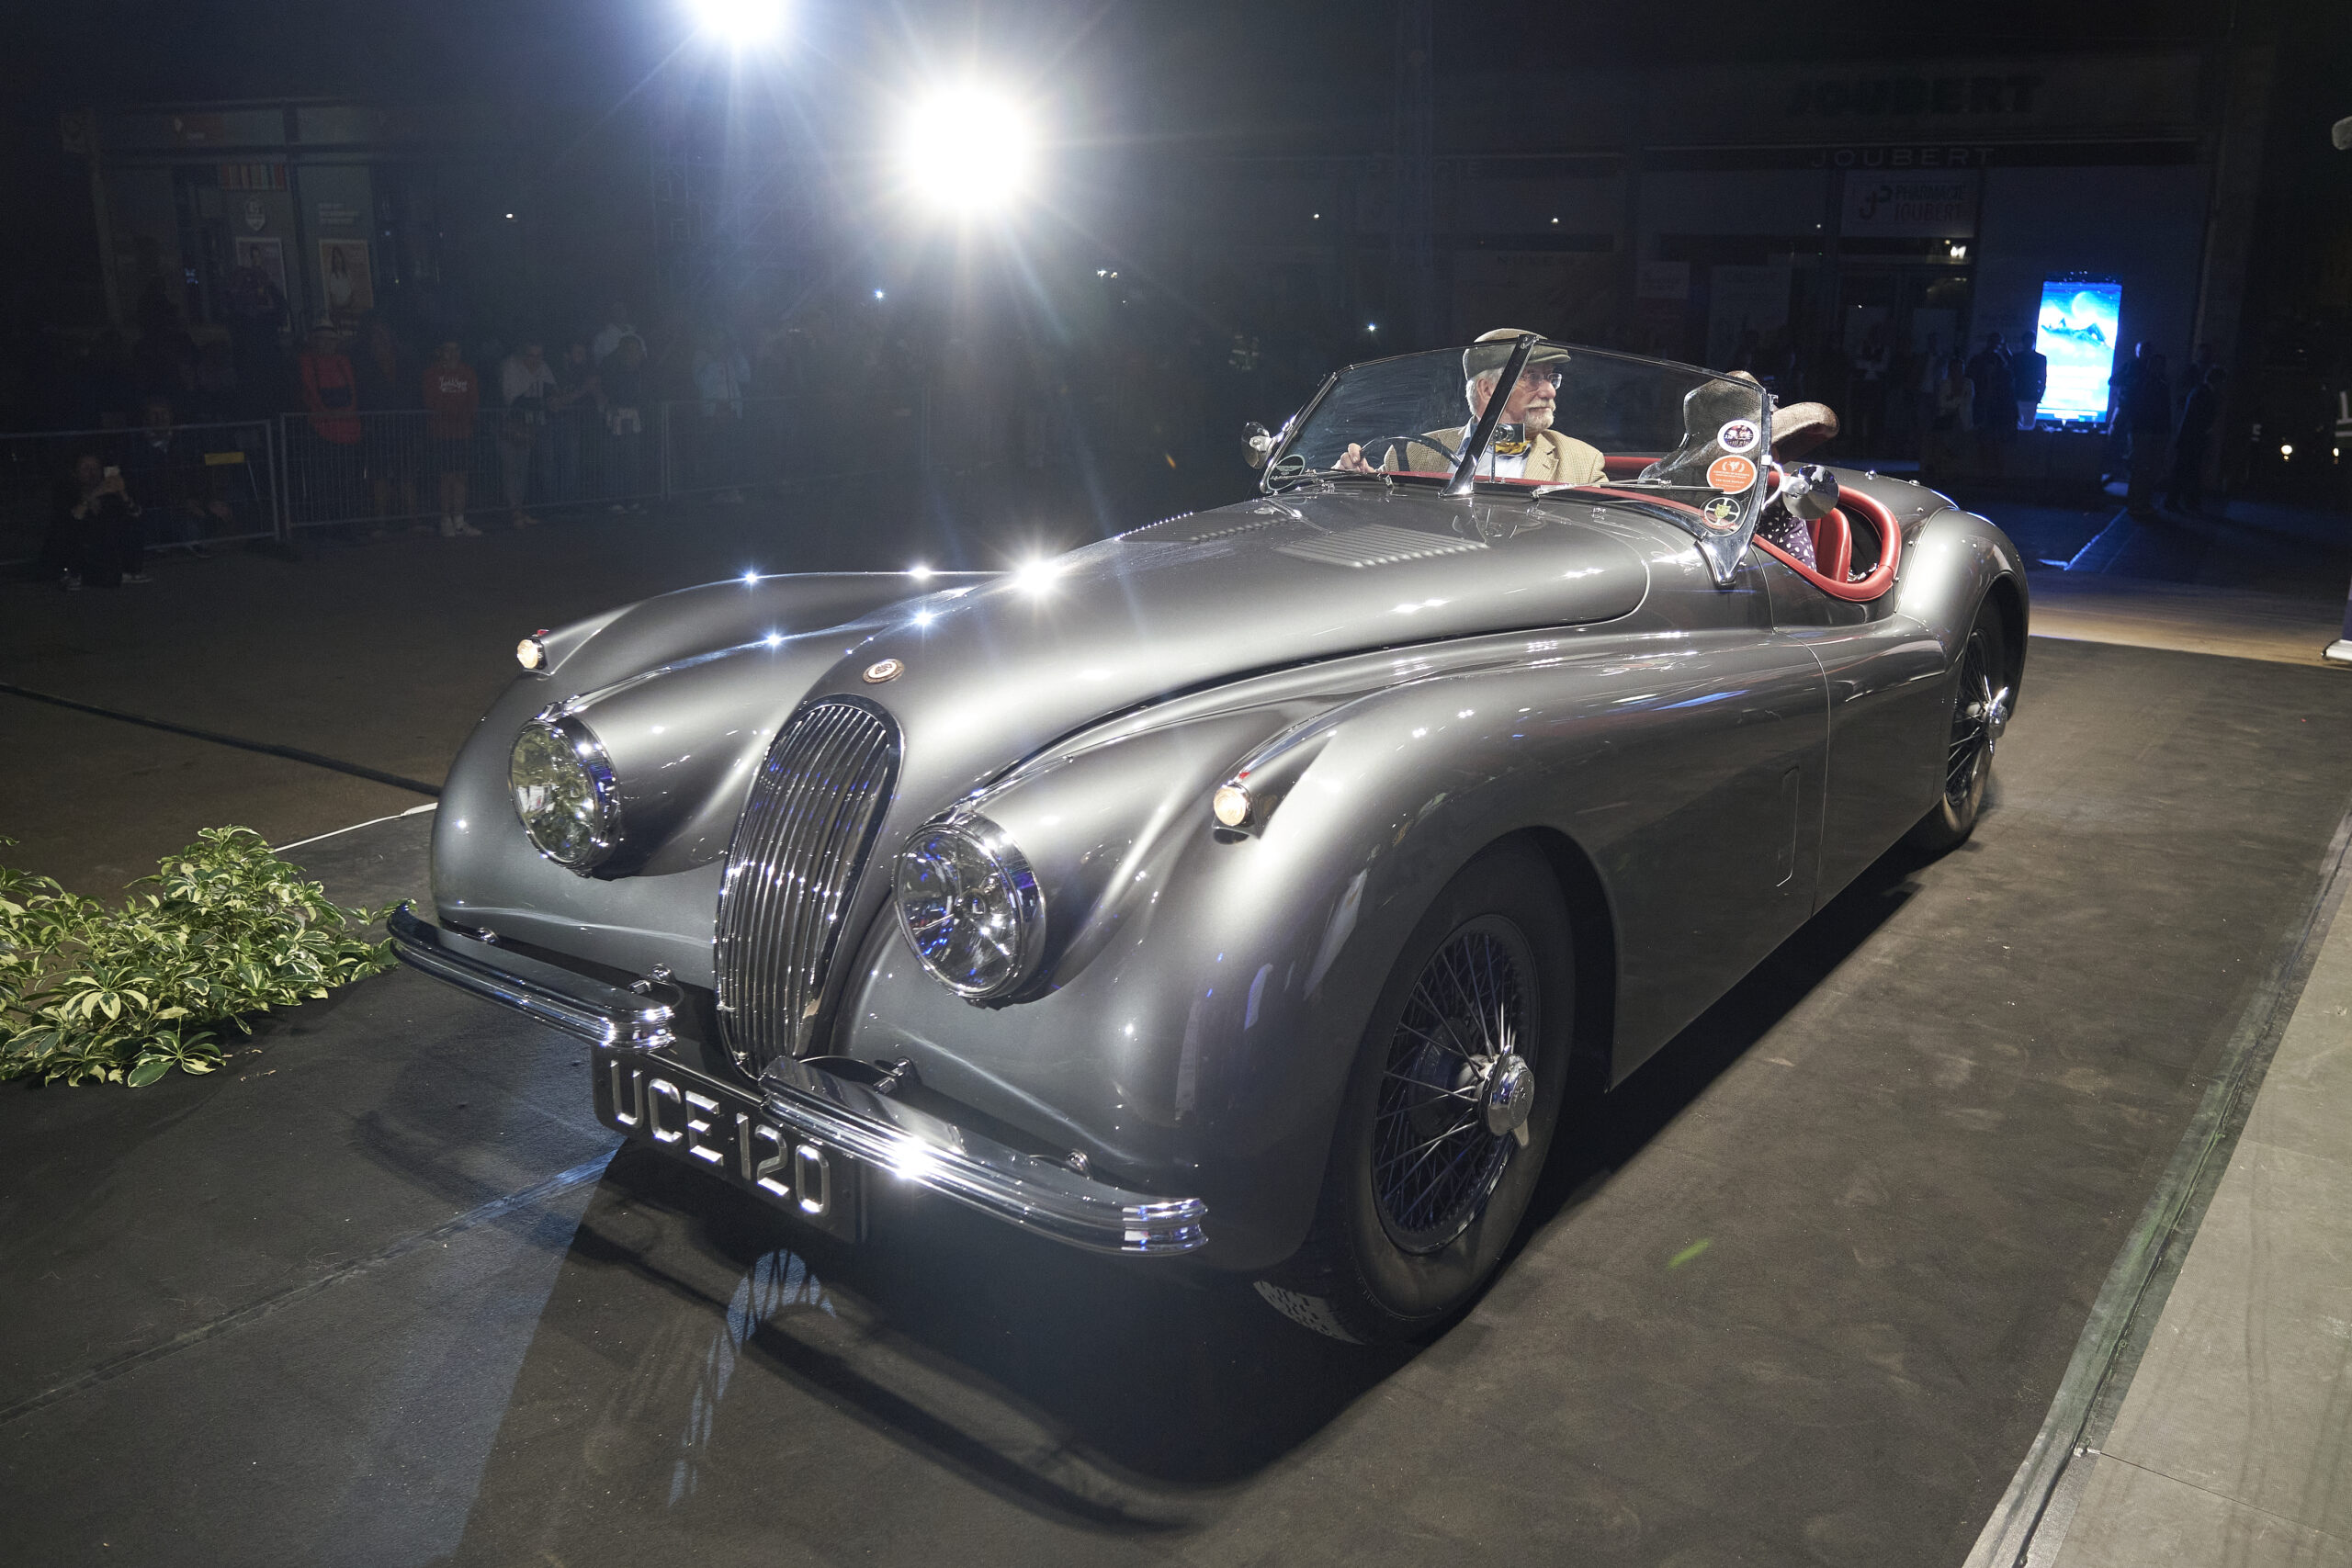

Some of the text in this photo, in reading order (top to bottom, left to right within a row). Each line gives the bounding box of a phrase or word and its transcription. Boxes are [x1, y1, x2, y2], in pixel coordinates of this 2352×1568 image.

[1786, 73, 2045, 116] JOUBERT
[1811, 148, 1995, 168] JOUBERT
[1895, 184, 1966, 200] PHARMACIE
[1894, 202, 1962, 221] JOUBERT
[610, 1059, 831, 1216] UCE 120
